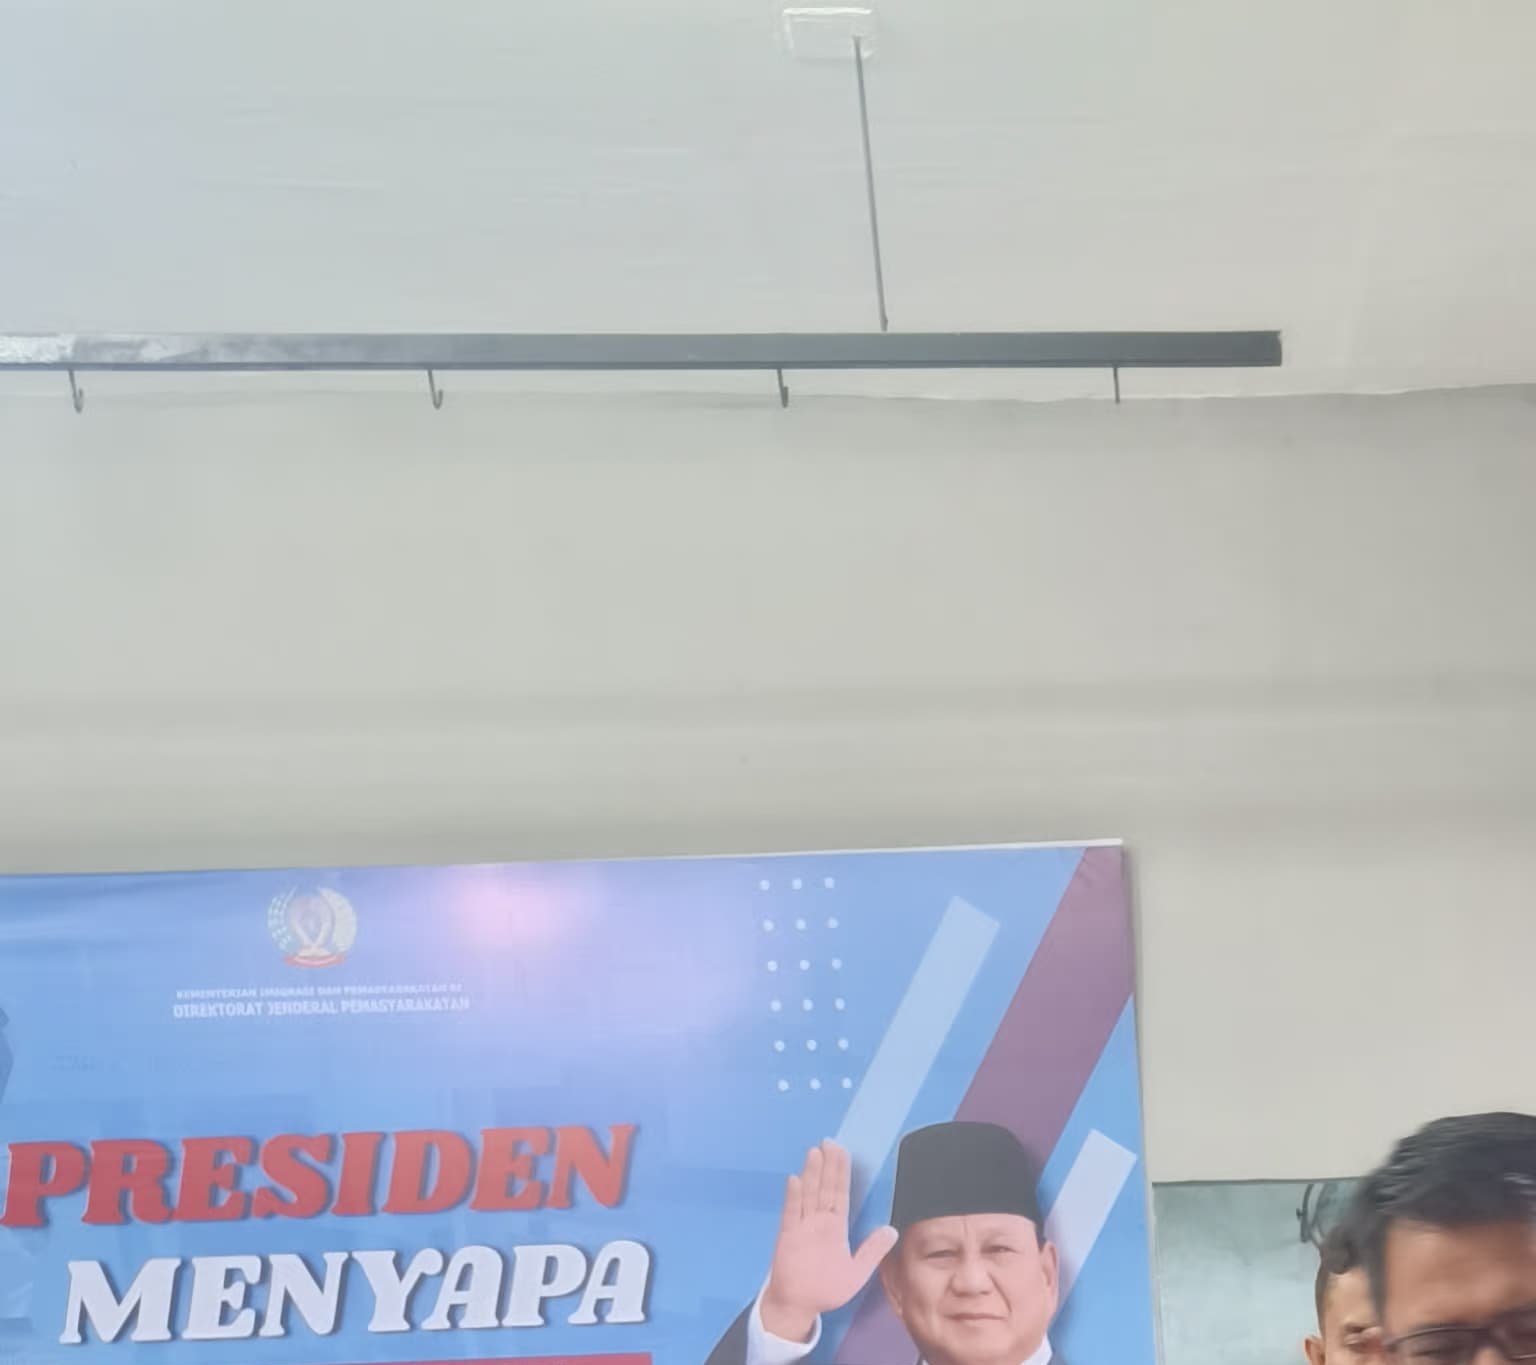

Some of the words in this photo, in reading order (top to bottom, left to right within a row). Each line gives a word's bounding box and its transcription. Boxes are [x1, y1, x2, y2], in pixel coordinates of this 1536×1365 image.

[173, 1001, 262, 1019] DIREKTORAT
[266, 999, 338, 1017] JENDERAL
[341, 996, 470, 1014] PEMASYARAKATAN
[0, 1123, 638, 1229] PRESIDEN
[59, 1240, 651, 1345] MENYAPA
